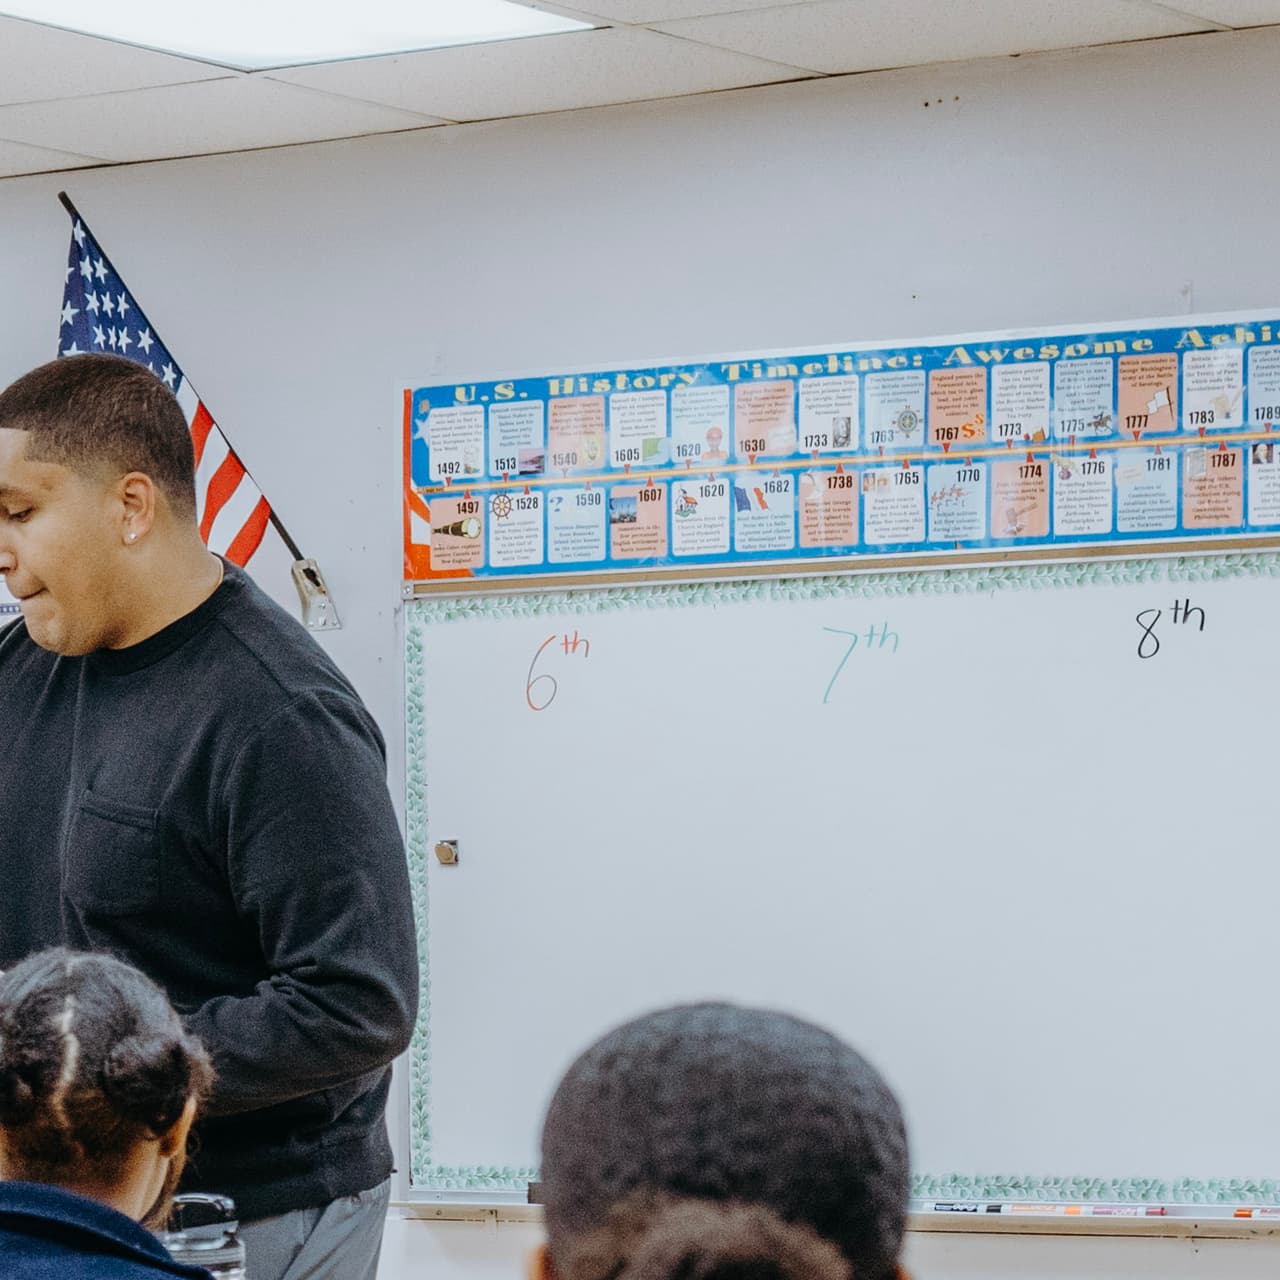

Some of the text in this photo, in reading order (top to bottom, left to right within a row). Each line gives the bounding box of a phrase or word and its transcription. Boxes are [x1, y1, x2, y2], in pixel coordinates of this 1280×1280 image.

[454, 382, 528, 403] U.S.
[548, 371, 702, 397] History
[721, 354, 923, 381] Timeline:
[942, 338, 1155, 366] Awesome
[1189, 411, 1214, 424] 1783
[1255, 406, 1280, 420] 1789
[1061, 419, 1085, 432] 1775
[1126, 415, 1149, 428] 1777
[935, 427, 959, 440] 1767
[999, 423, 1021, 436] 1773
[804, 434, 828, 447] 1733
[871, 430, 894, 443] 1763
[677, 444, 701, 457] 1620
[740, 439, 766, 452] 1630
[553, 452, 577, 466] 1540
[615, 448, 640, 462] 1605
[1211, 453, 1236, 467] 1787
[437, 462, 460, 475] 1492
[495, 457, 517, 471] 1513
[1081, 461, 1105, 474] 1776
[1146, 458, 1170, 471] 1781
[894, 471, 919, 485] 1765
[957, 469, 980, 483] 1770
[1019, 465, 1042, 478] 1774
[764, 480, 790, 494] 1682
[827, 476, 852, 489] 1738
[639, 488, 662, 502] 1607
[699, 484, 725, 498] 1620
[516, 497, 539, 509] 1528
[576, 493, 601, 506] 1590
[456, 501, 479, 514] 1497
[1135, 598, 1206, 659] 8th
[821, 620, 899, 705] 7th
[525, 629, 590, 711] 6th
